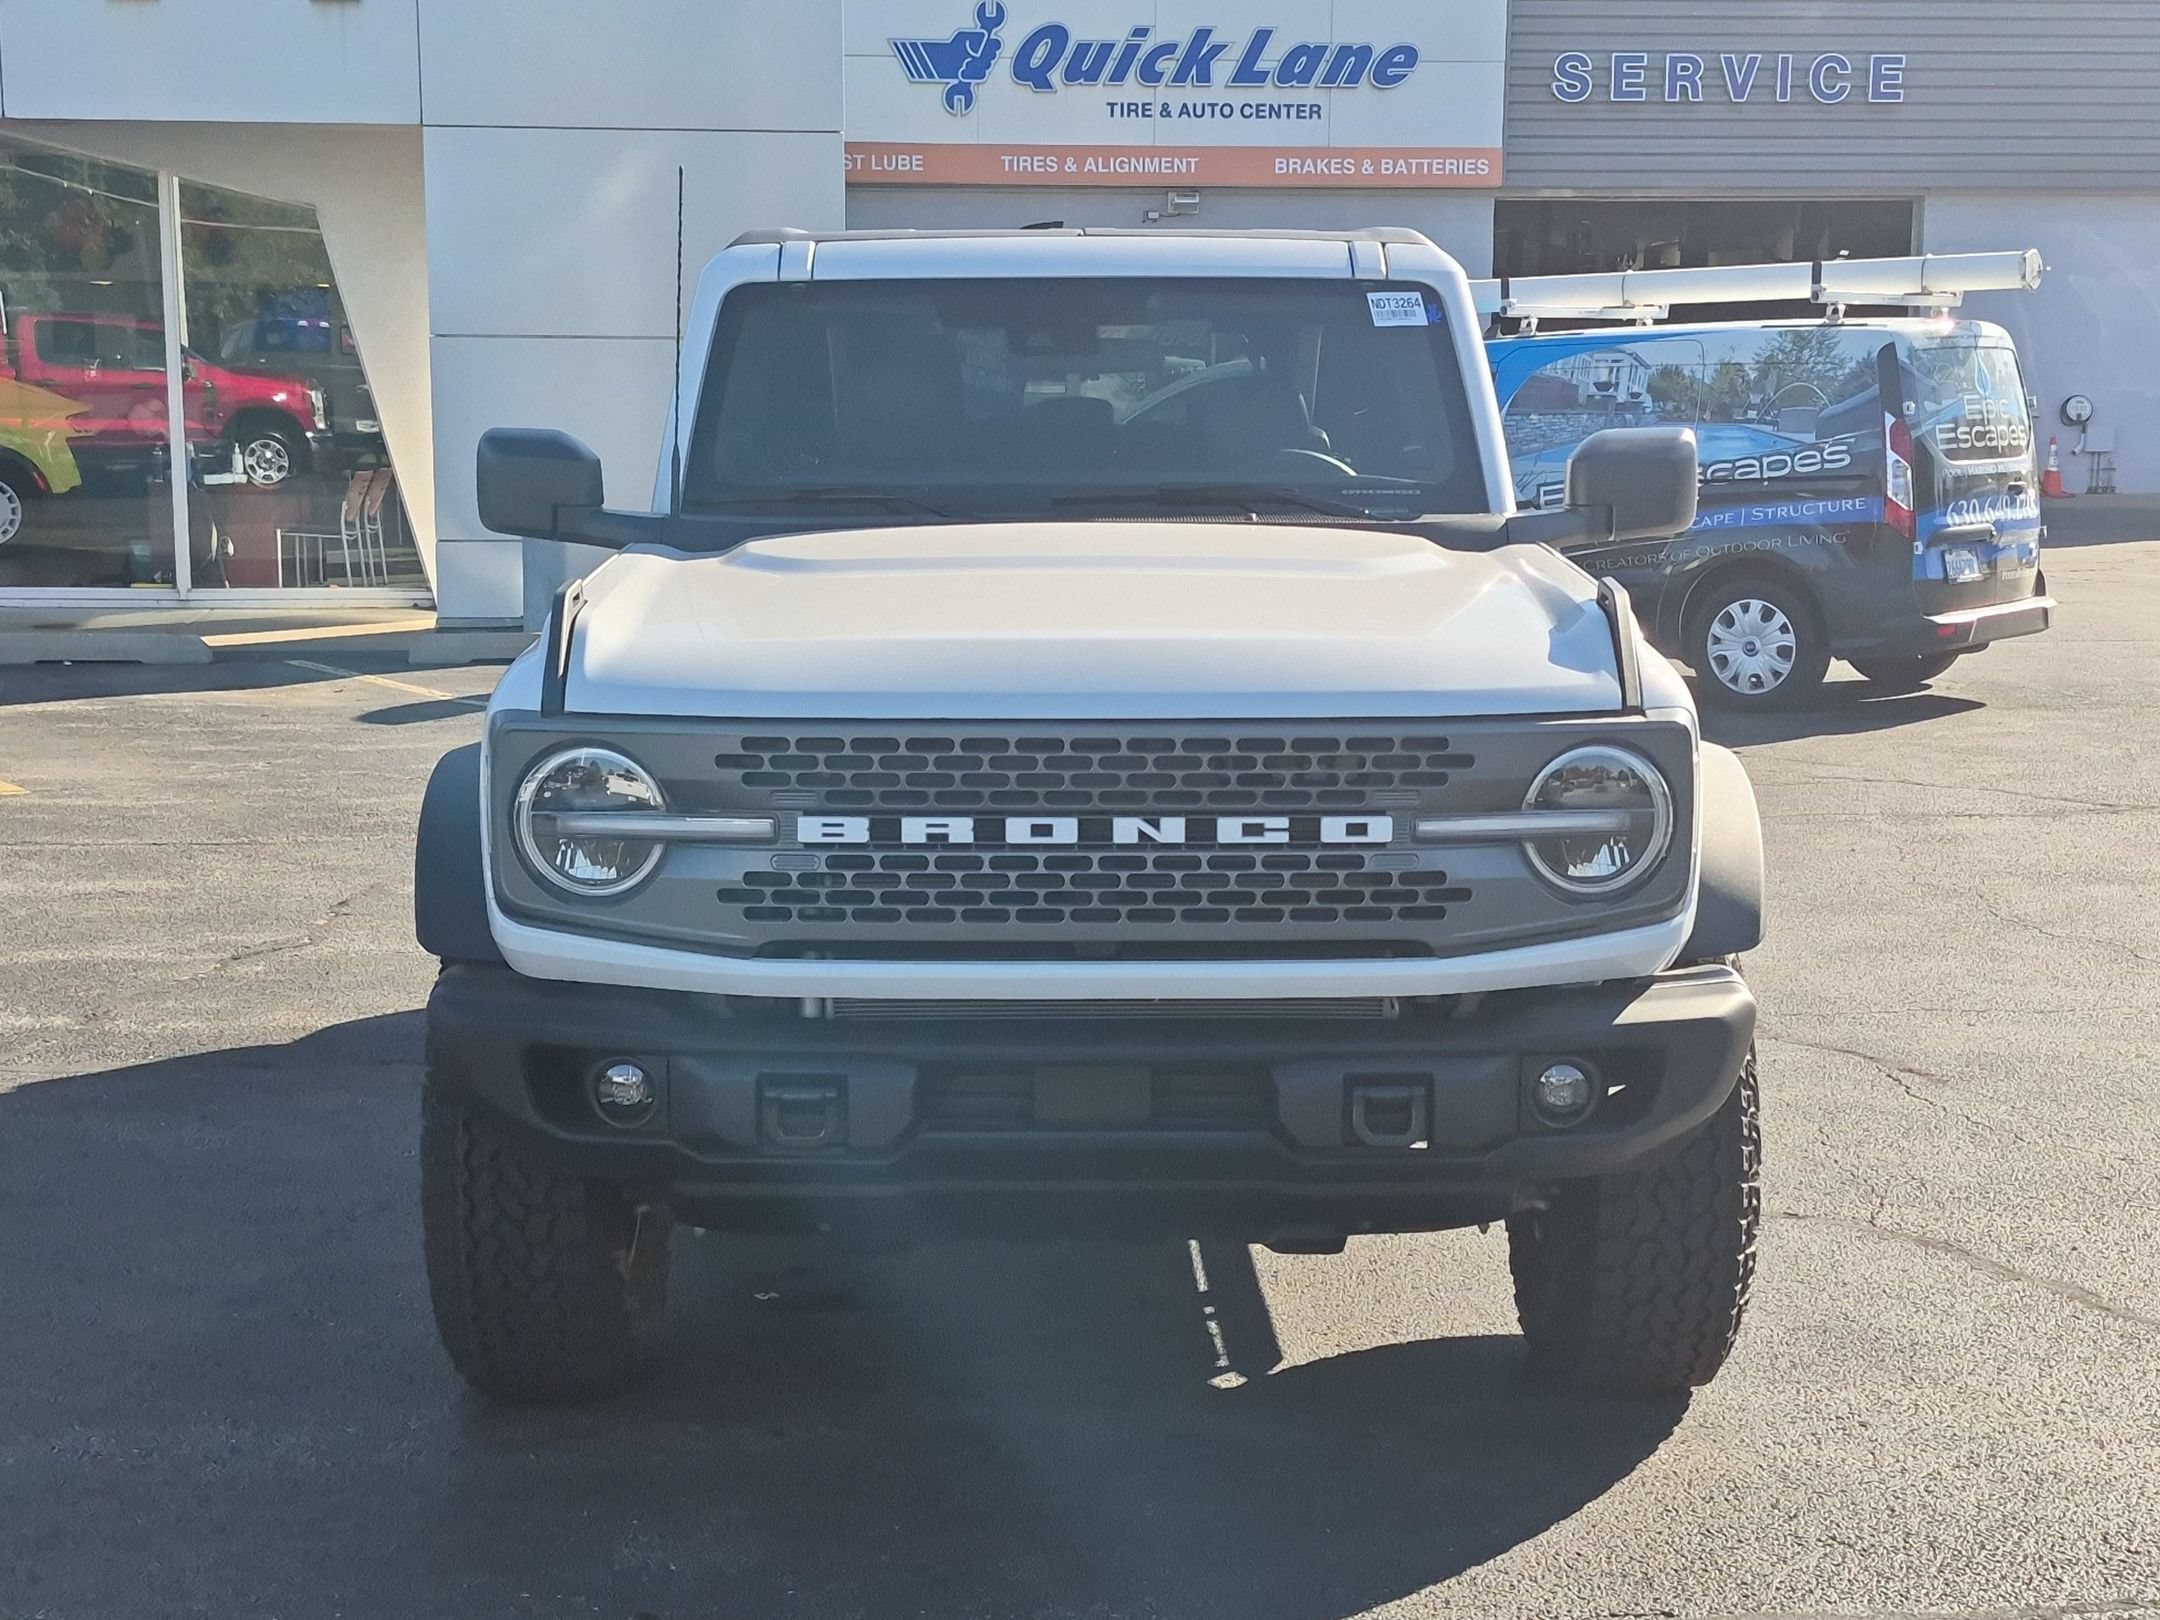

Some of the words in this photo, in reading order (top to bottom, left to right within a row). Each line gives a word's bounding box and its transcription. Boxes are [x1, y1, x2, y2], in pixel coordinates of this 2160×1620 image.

[1011, 22, 1235, 93] Quick
[1225, 26, 1421, 89] Lane
[1552, 51, 1905, 103] SERVICE
[1106, 102, 1153, 118] TIRE
[1159, 102, 1172, 118] &
[1178, 102, 1234, 119] AUTO
[1240, 103, 1322, 119] CENTER
[871, 154, 924, 171] LUBE
[1001, 155, 1058, 172] TIRES
[1064, 156, 1077, 172] &
[1084, 156, 1200, 173] ALIGNMENT
[1274, 158, 1355, 174] BRAKES
[1361, 159, 1374, 174] &
[1381, 159, 1490, 175] BATTERIES
[1370, 297, 1421, 309] NDT3264
[1963, 394, 2010, 425] Epic
[1936, 423, 2028, 453] Escapes
[1751, 497, 1866, 521] STRUCTURE
[1583, 553, 1666, 572] CREATORS
[1670, 548, 1691, 562] OF
[1695, 537, 1782, 557] OUTDOOR
[1788, 531, 1847, 548] LIVING
[796, 815, 1394, 844] BRONCO
